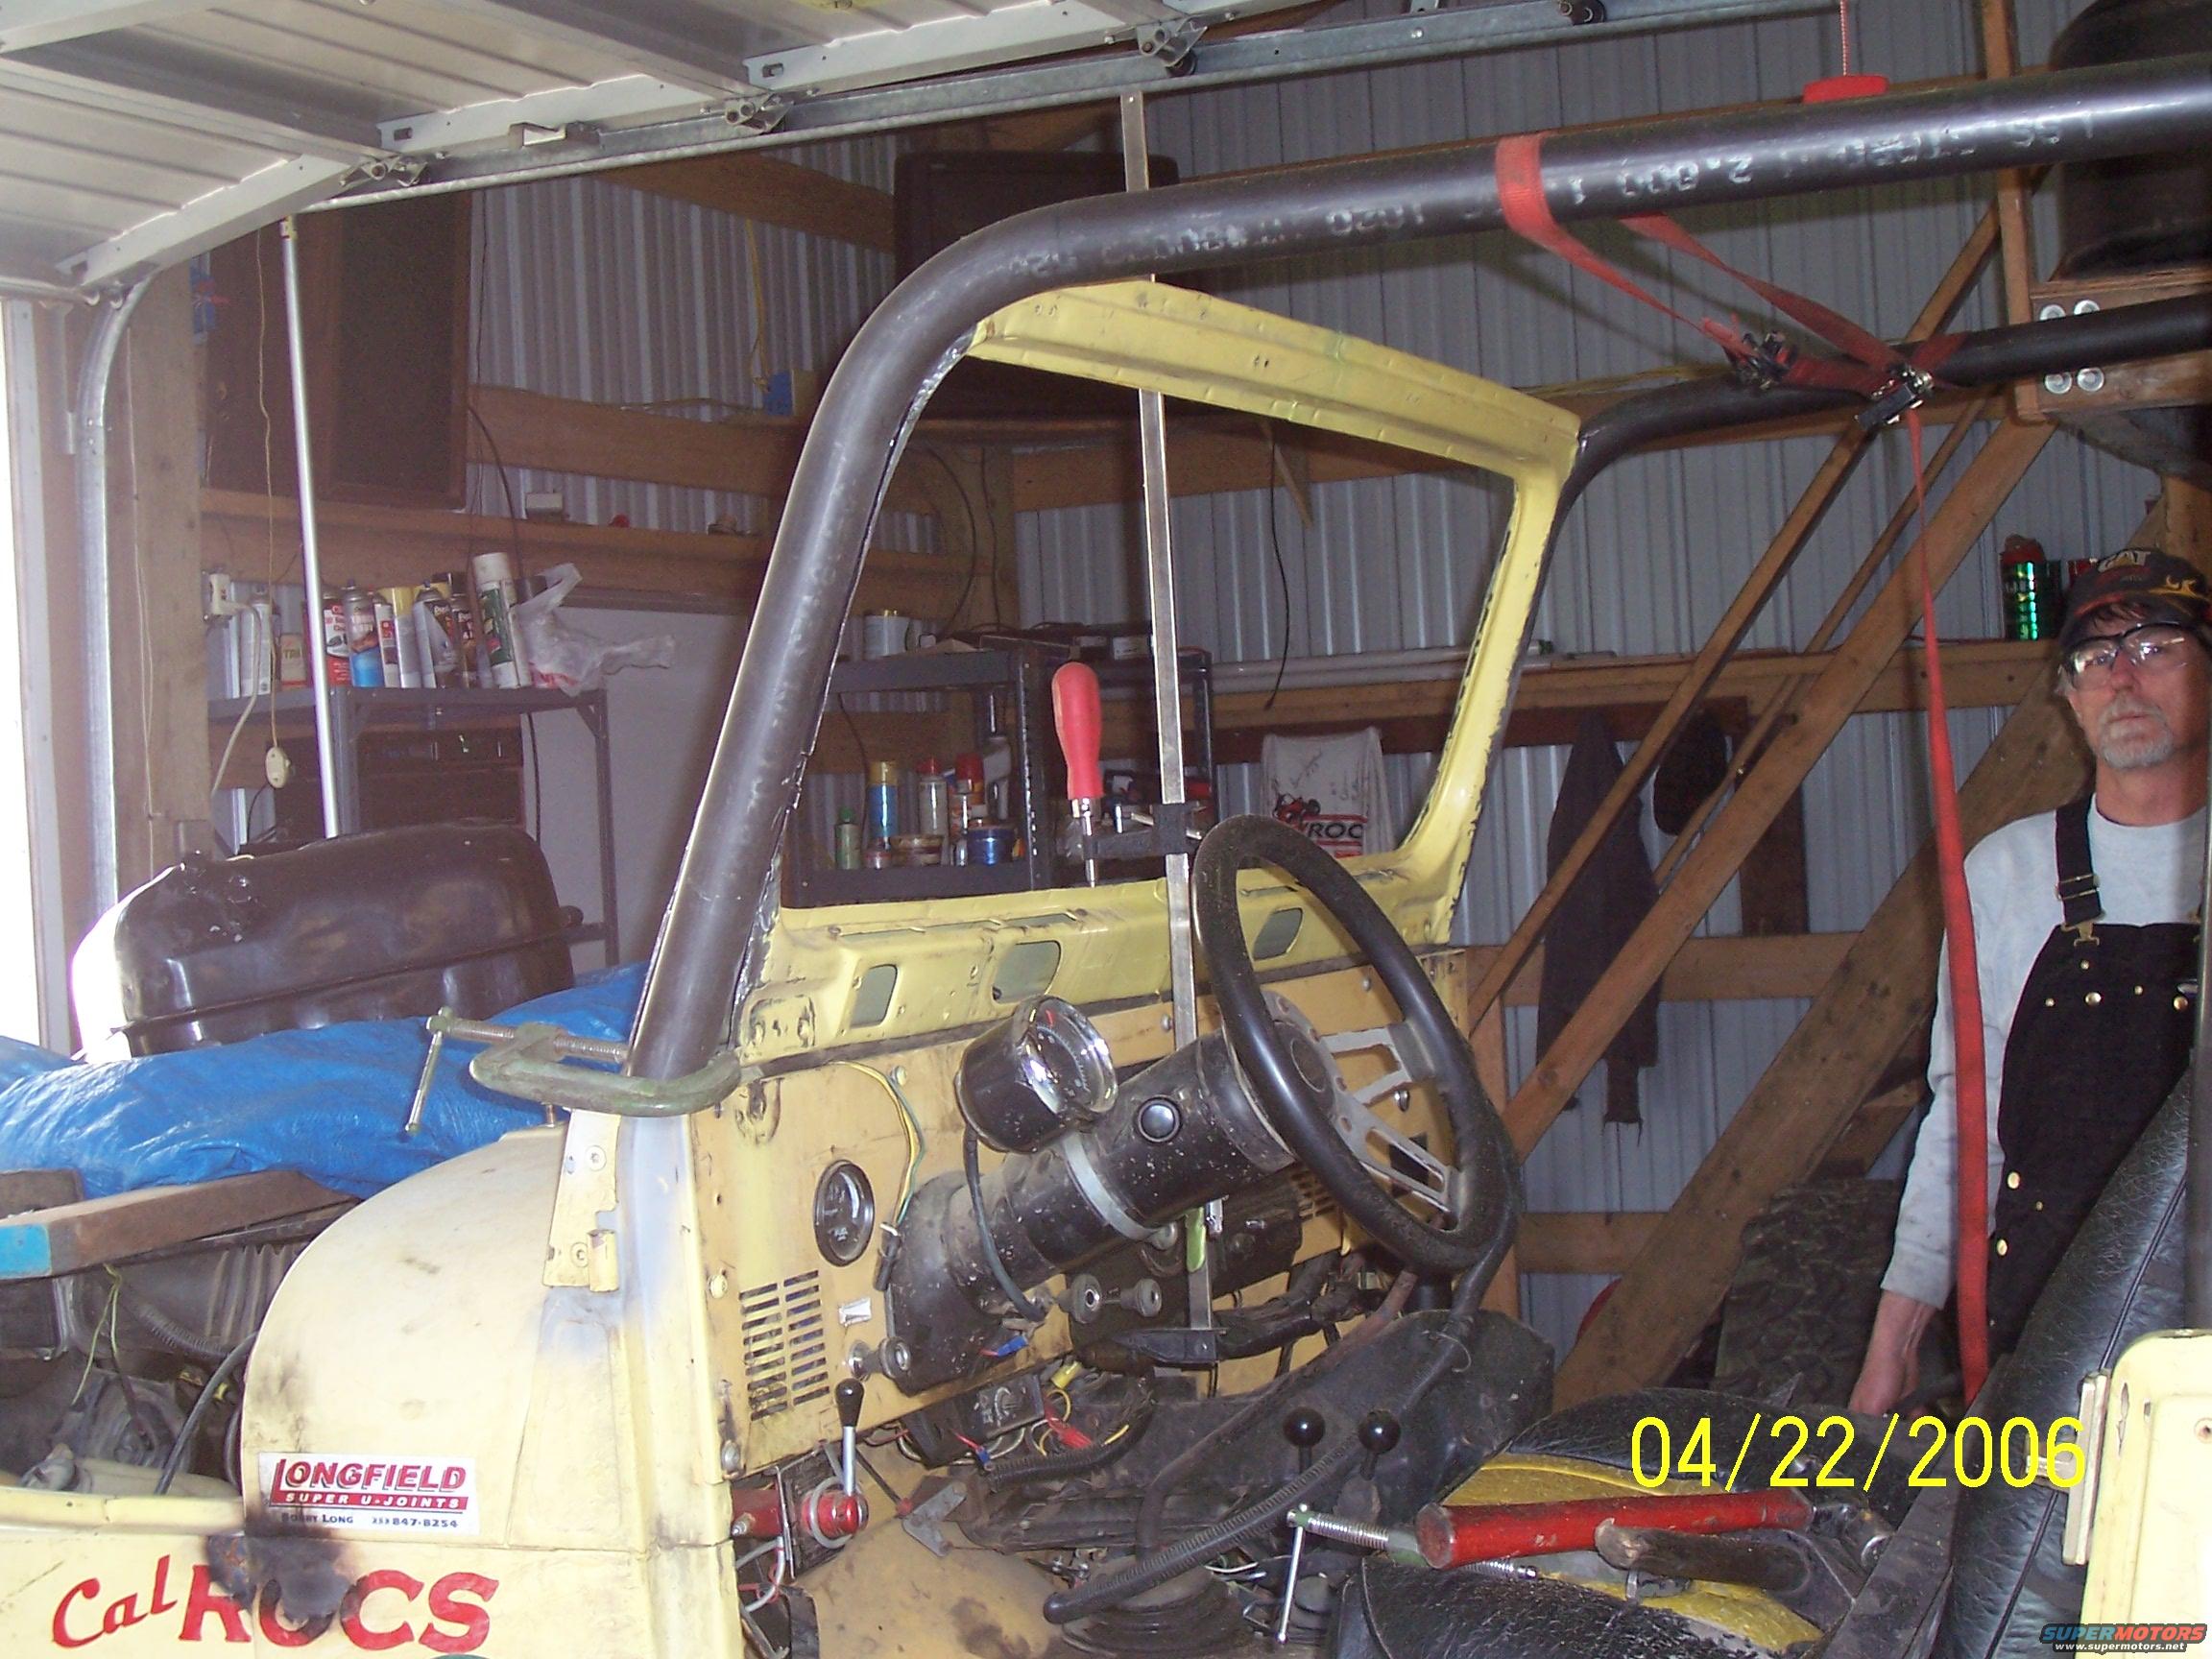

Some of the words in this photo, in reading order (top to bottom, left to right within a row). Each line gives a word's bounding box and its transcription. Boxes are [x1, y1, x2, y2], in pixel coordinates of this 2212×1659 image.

[272, 1458, 467, 1495] LONGFIELD
[285, 1491, 349, 1505] SUPER
[360, 1494, 461, 1510] U-JOINTS
[323, 1513, 353, 1525] LONG
[52, 1554, 178, 1648] Cal
